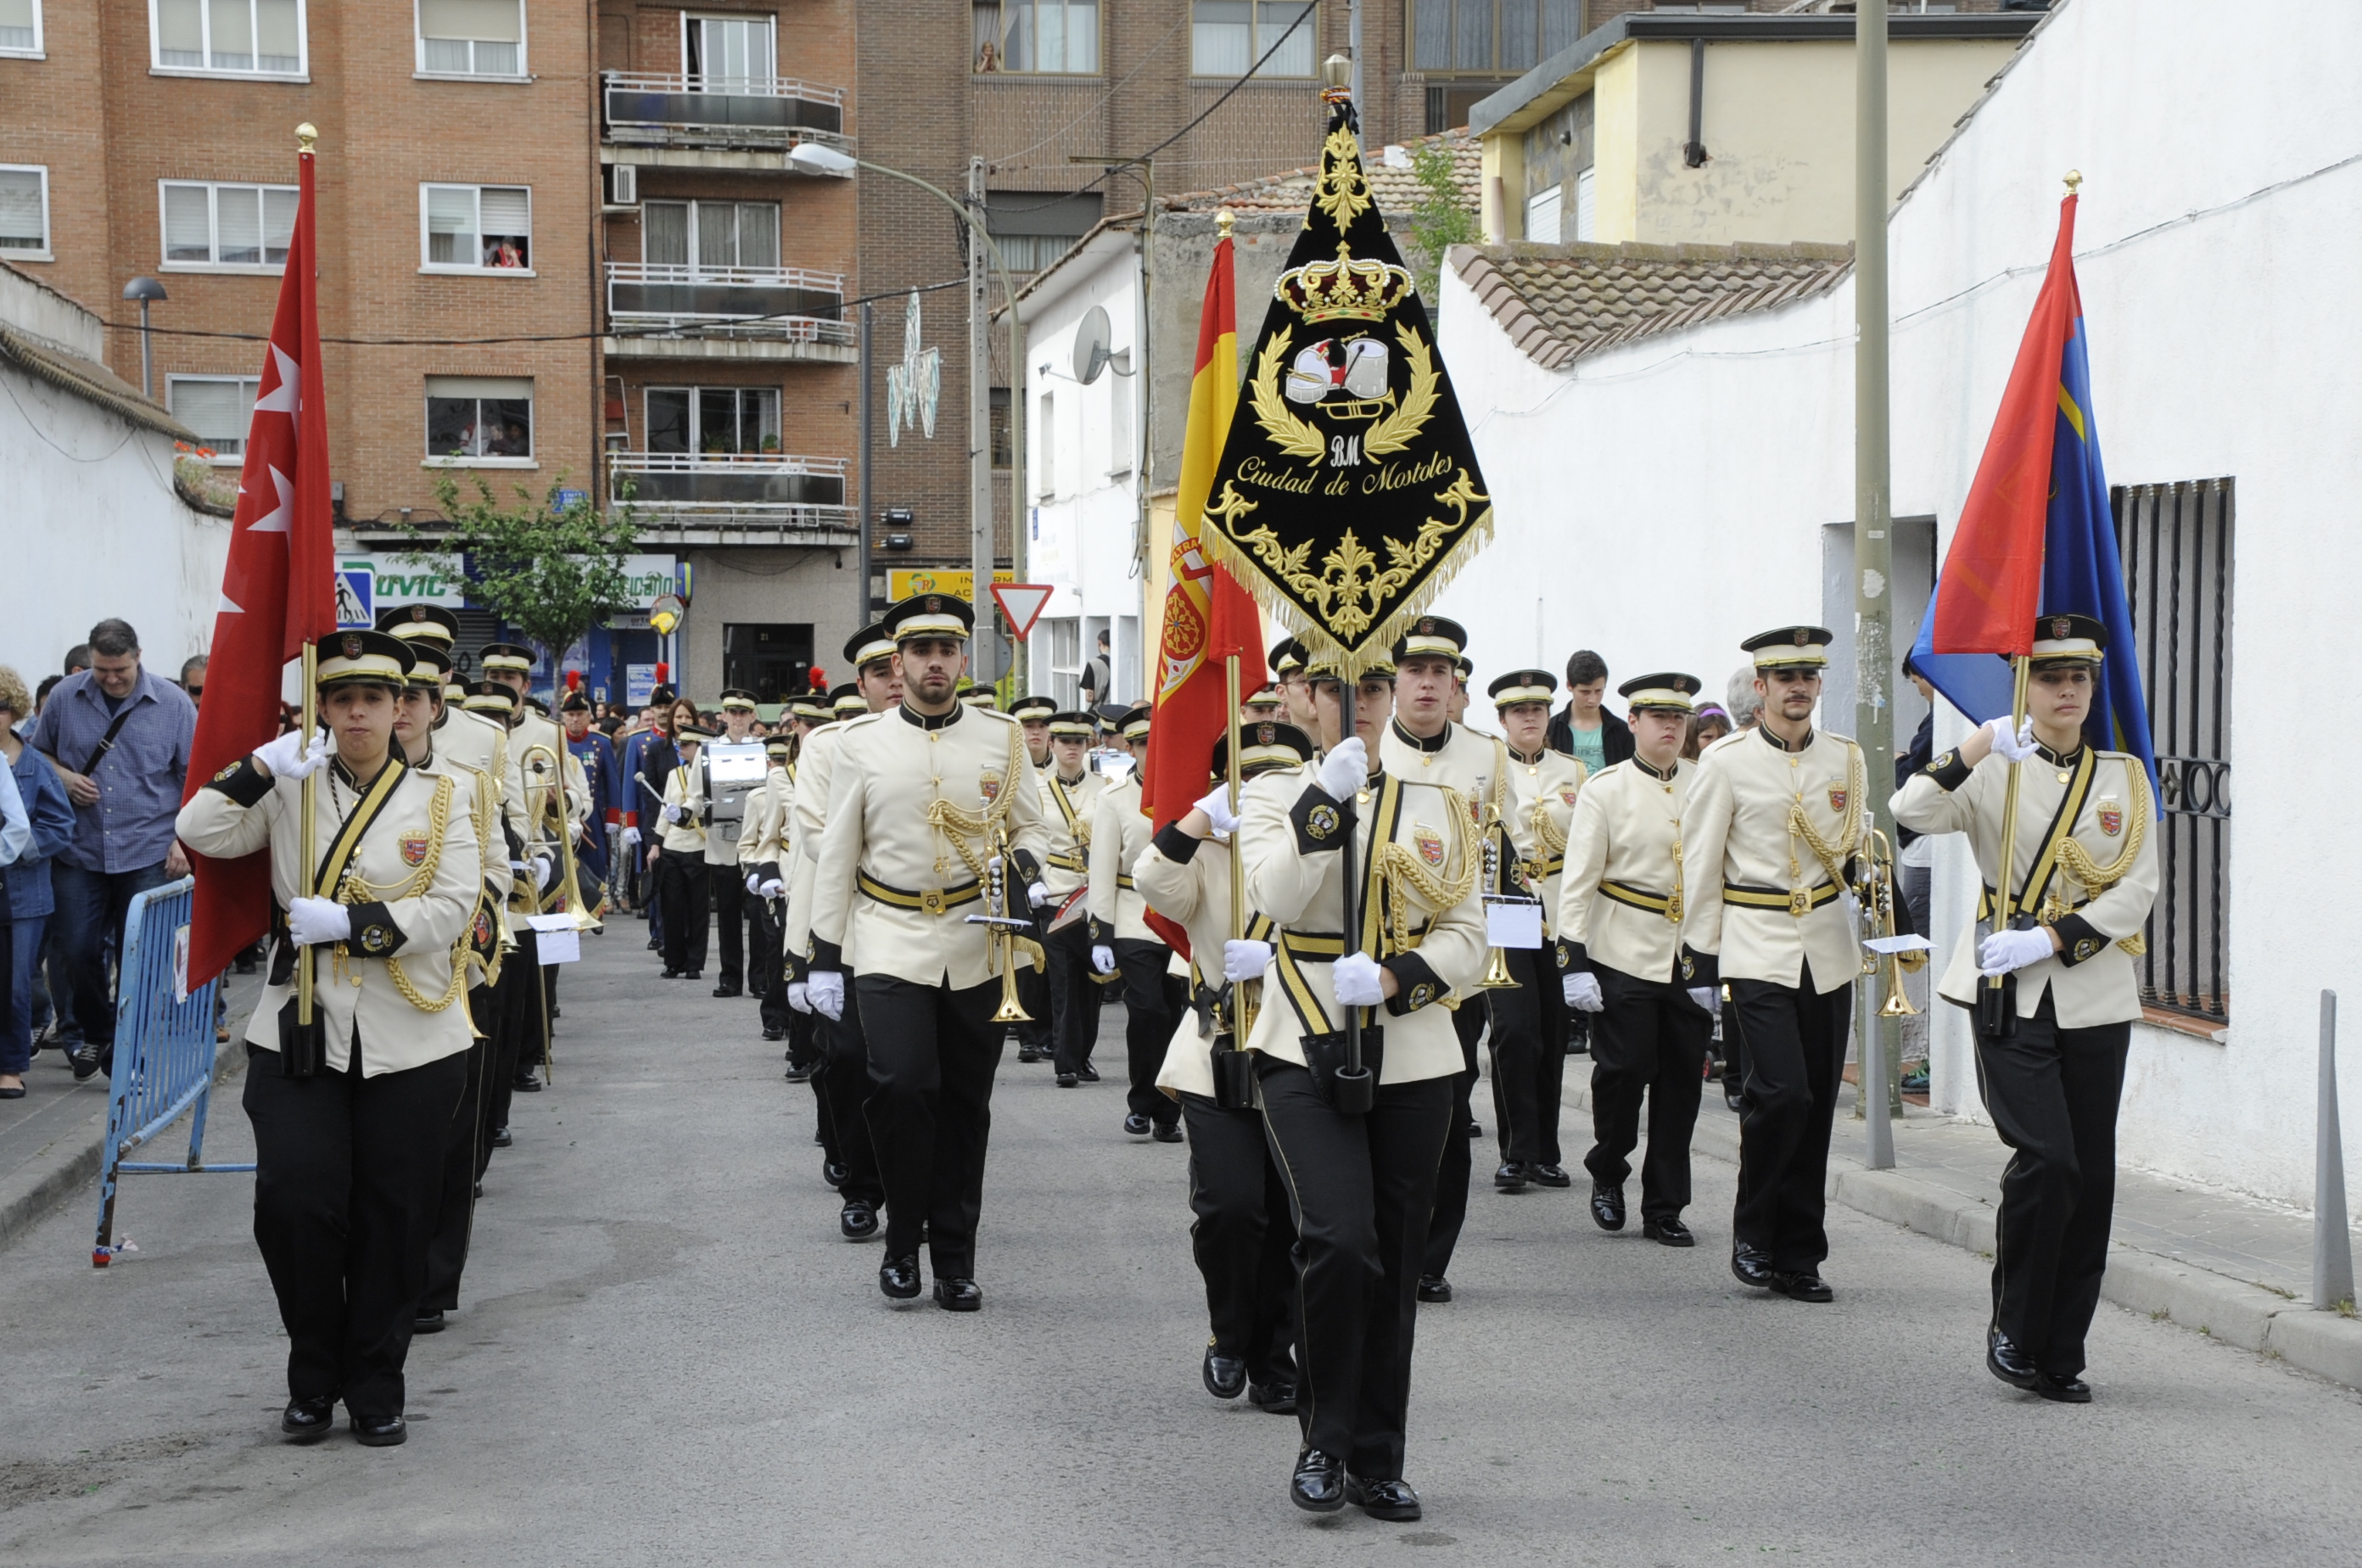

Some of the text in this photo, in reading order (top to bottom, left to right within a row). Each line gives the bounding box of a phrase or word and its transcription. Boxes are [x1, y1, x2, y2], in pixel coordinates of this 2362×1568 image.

[1330, 435, 1361, 467] BM
[1237, 451, 1452, 496] Ciudad de Mostoles
